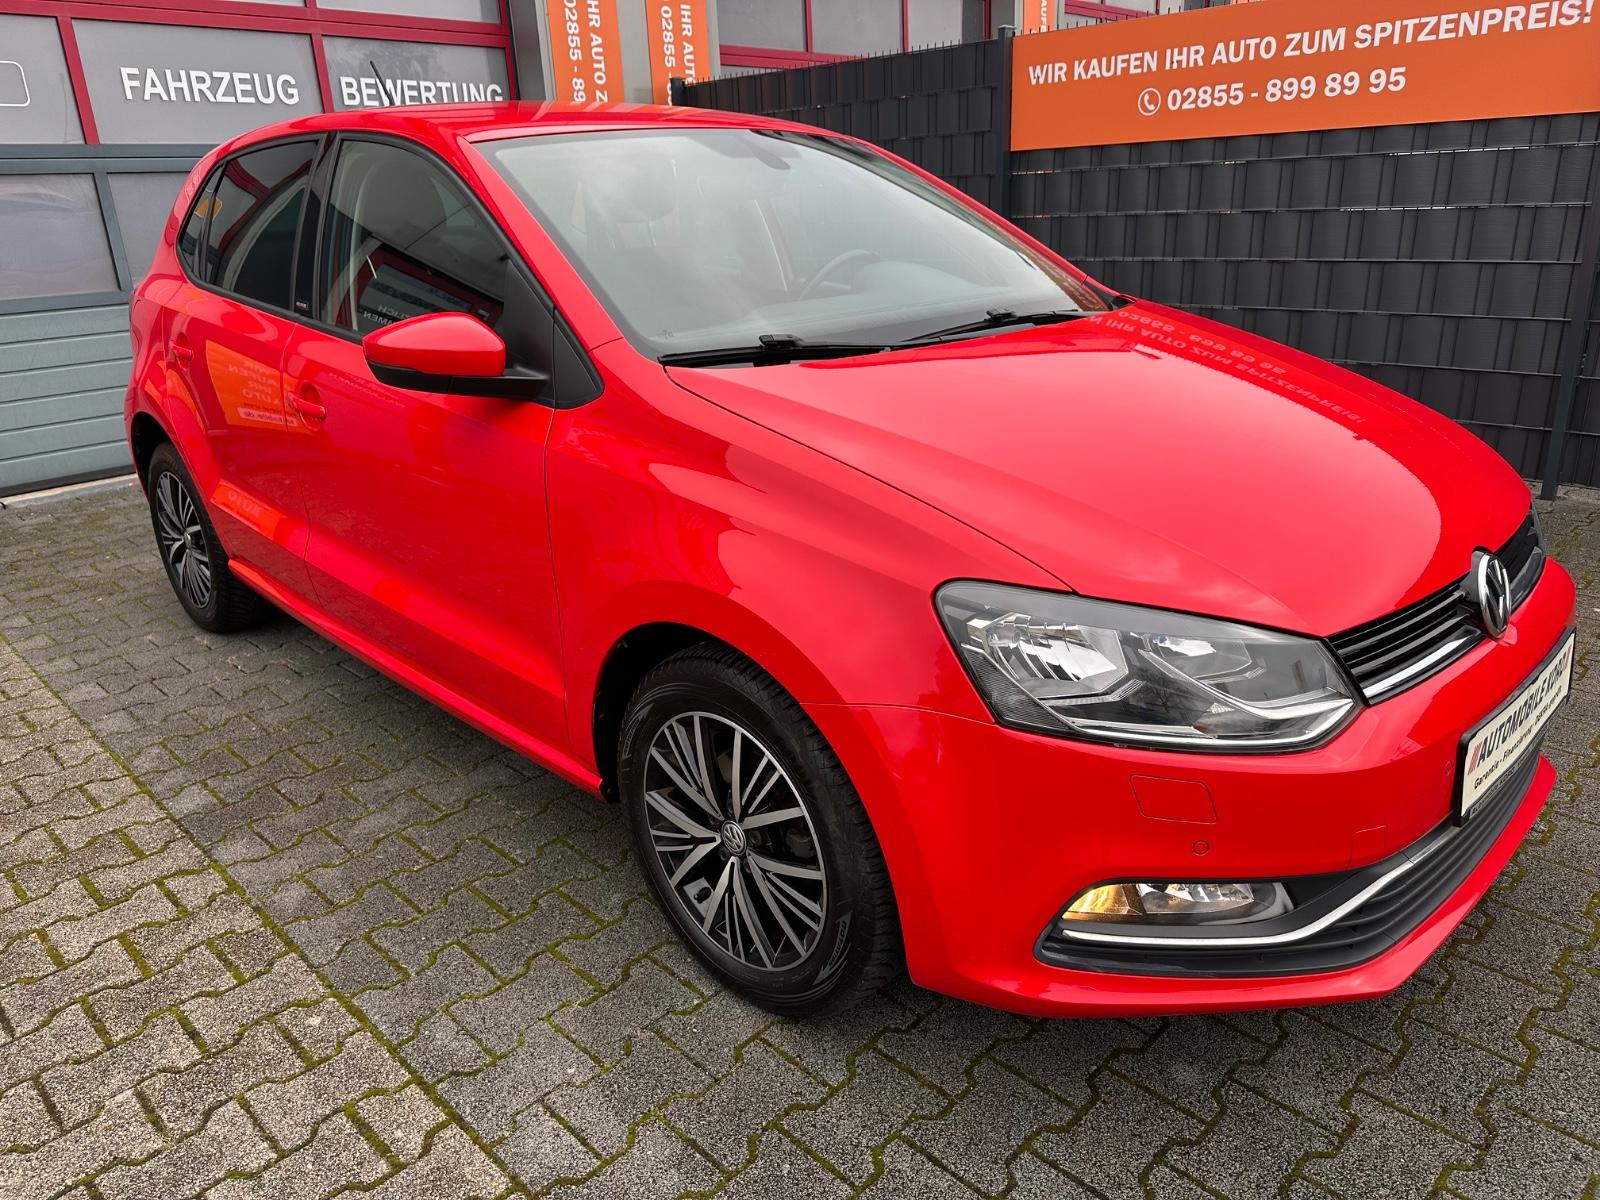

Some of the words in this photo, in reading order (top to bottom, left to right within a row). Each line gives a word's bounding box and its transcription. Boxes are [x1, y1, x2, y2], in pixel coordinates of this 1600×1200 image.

[564, 0, 582, 61] 02855
[660, 6, 675, 67] 02855
[680, 4, 692, 37] IHR
[1029, 63, 1066, 85] WIR
[1073, 51, 1157, 80] KAUFEN
[1165, 45, 1205, 70] IHR
[1211, 36, 1277, 65] AUTO
[1283, 27, 1346, 56] ZUM
[1353, 0, 1594, 48] SPITZENPREIS!
[590, 32, 607, 85] AUTO
[120, 67, 299, 105] FAHRZEUG
[339, 76, 503, 106] BEWERTUNG
[1167, 83, 1244, 110] 02855
[1265, 75, 1316, 102] 899
[1324, 71, 1360, 97] 89
[1368, 66, 1406, 93] 95
[1477, 677, 1547, 767] AUTOMOBILE
[1474, 759, 1499, 789] Garantie
